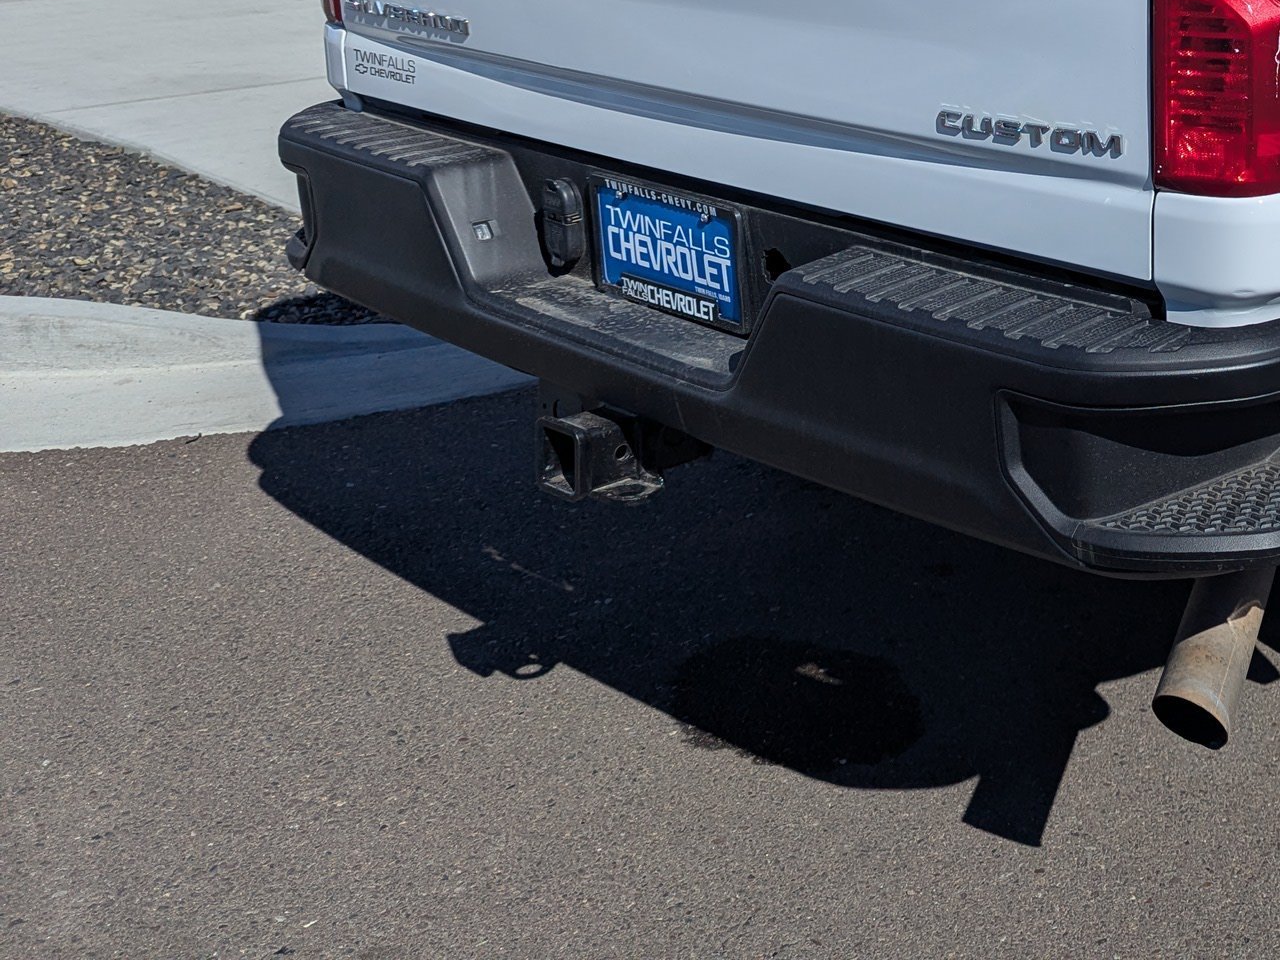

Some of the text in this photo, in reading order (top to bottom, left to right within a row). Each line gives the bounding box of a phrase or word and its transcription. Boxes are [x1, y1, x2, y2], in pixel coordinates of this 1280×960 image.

[353, 48, 416, 74] TWINFALLS
[370, 66, 416, 85] CHEVROLET
[936, 109, 1124, 159] CUSTOM
[604, 178, 717, 218] TWINFALLS-CHEVY.COM
[607, 225, 731, 293] CHEVROLET
[621, 276, 648, 294] TWIN
[622, 287, 648, 302] FALLS
[647, 285, 715, 322] CHEVROLET
